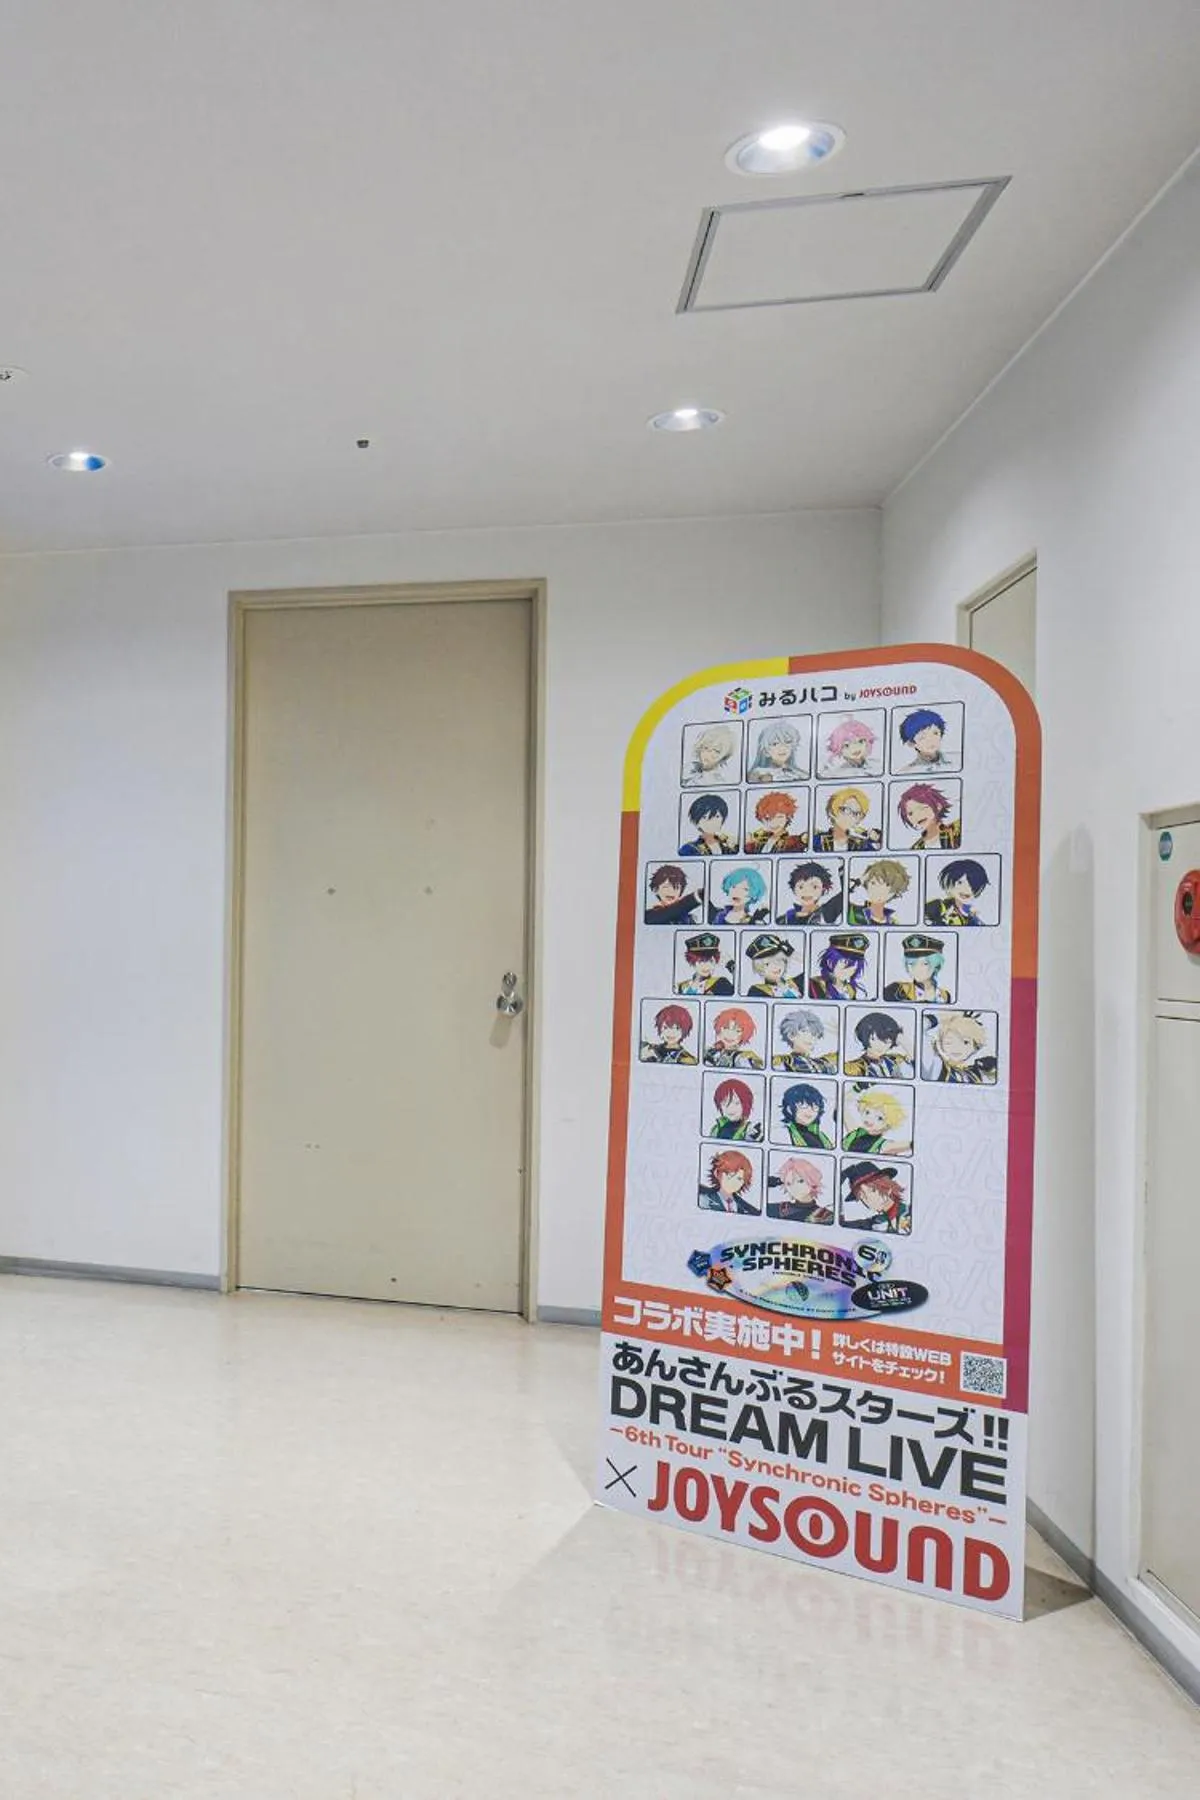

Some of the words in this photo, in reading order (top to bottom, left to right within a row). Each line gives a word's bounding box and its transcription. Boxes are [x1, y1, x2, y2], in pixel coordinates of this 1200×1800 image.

[758, 686, 838, 708] みるハコ
[844, 691, 857, 702] by
[742, 1257, 857, 1289] SPHERES
[867, 1287, 908, 1301] UNIT
[611, 1376, 828, 1463] DREAM
[847, 1426, 1007, 1505] LIVE
[664, 1434, 714, 1461] Tour
[647, 1460, 1010, 1601] JOYSOUND
